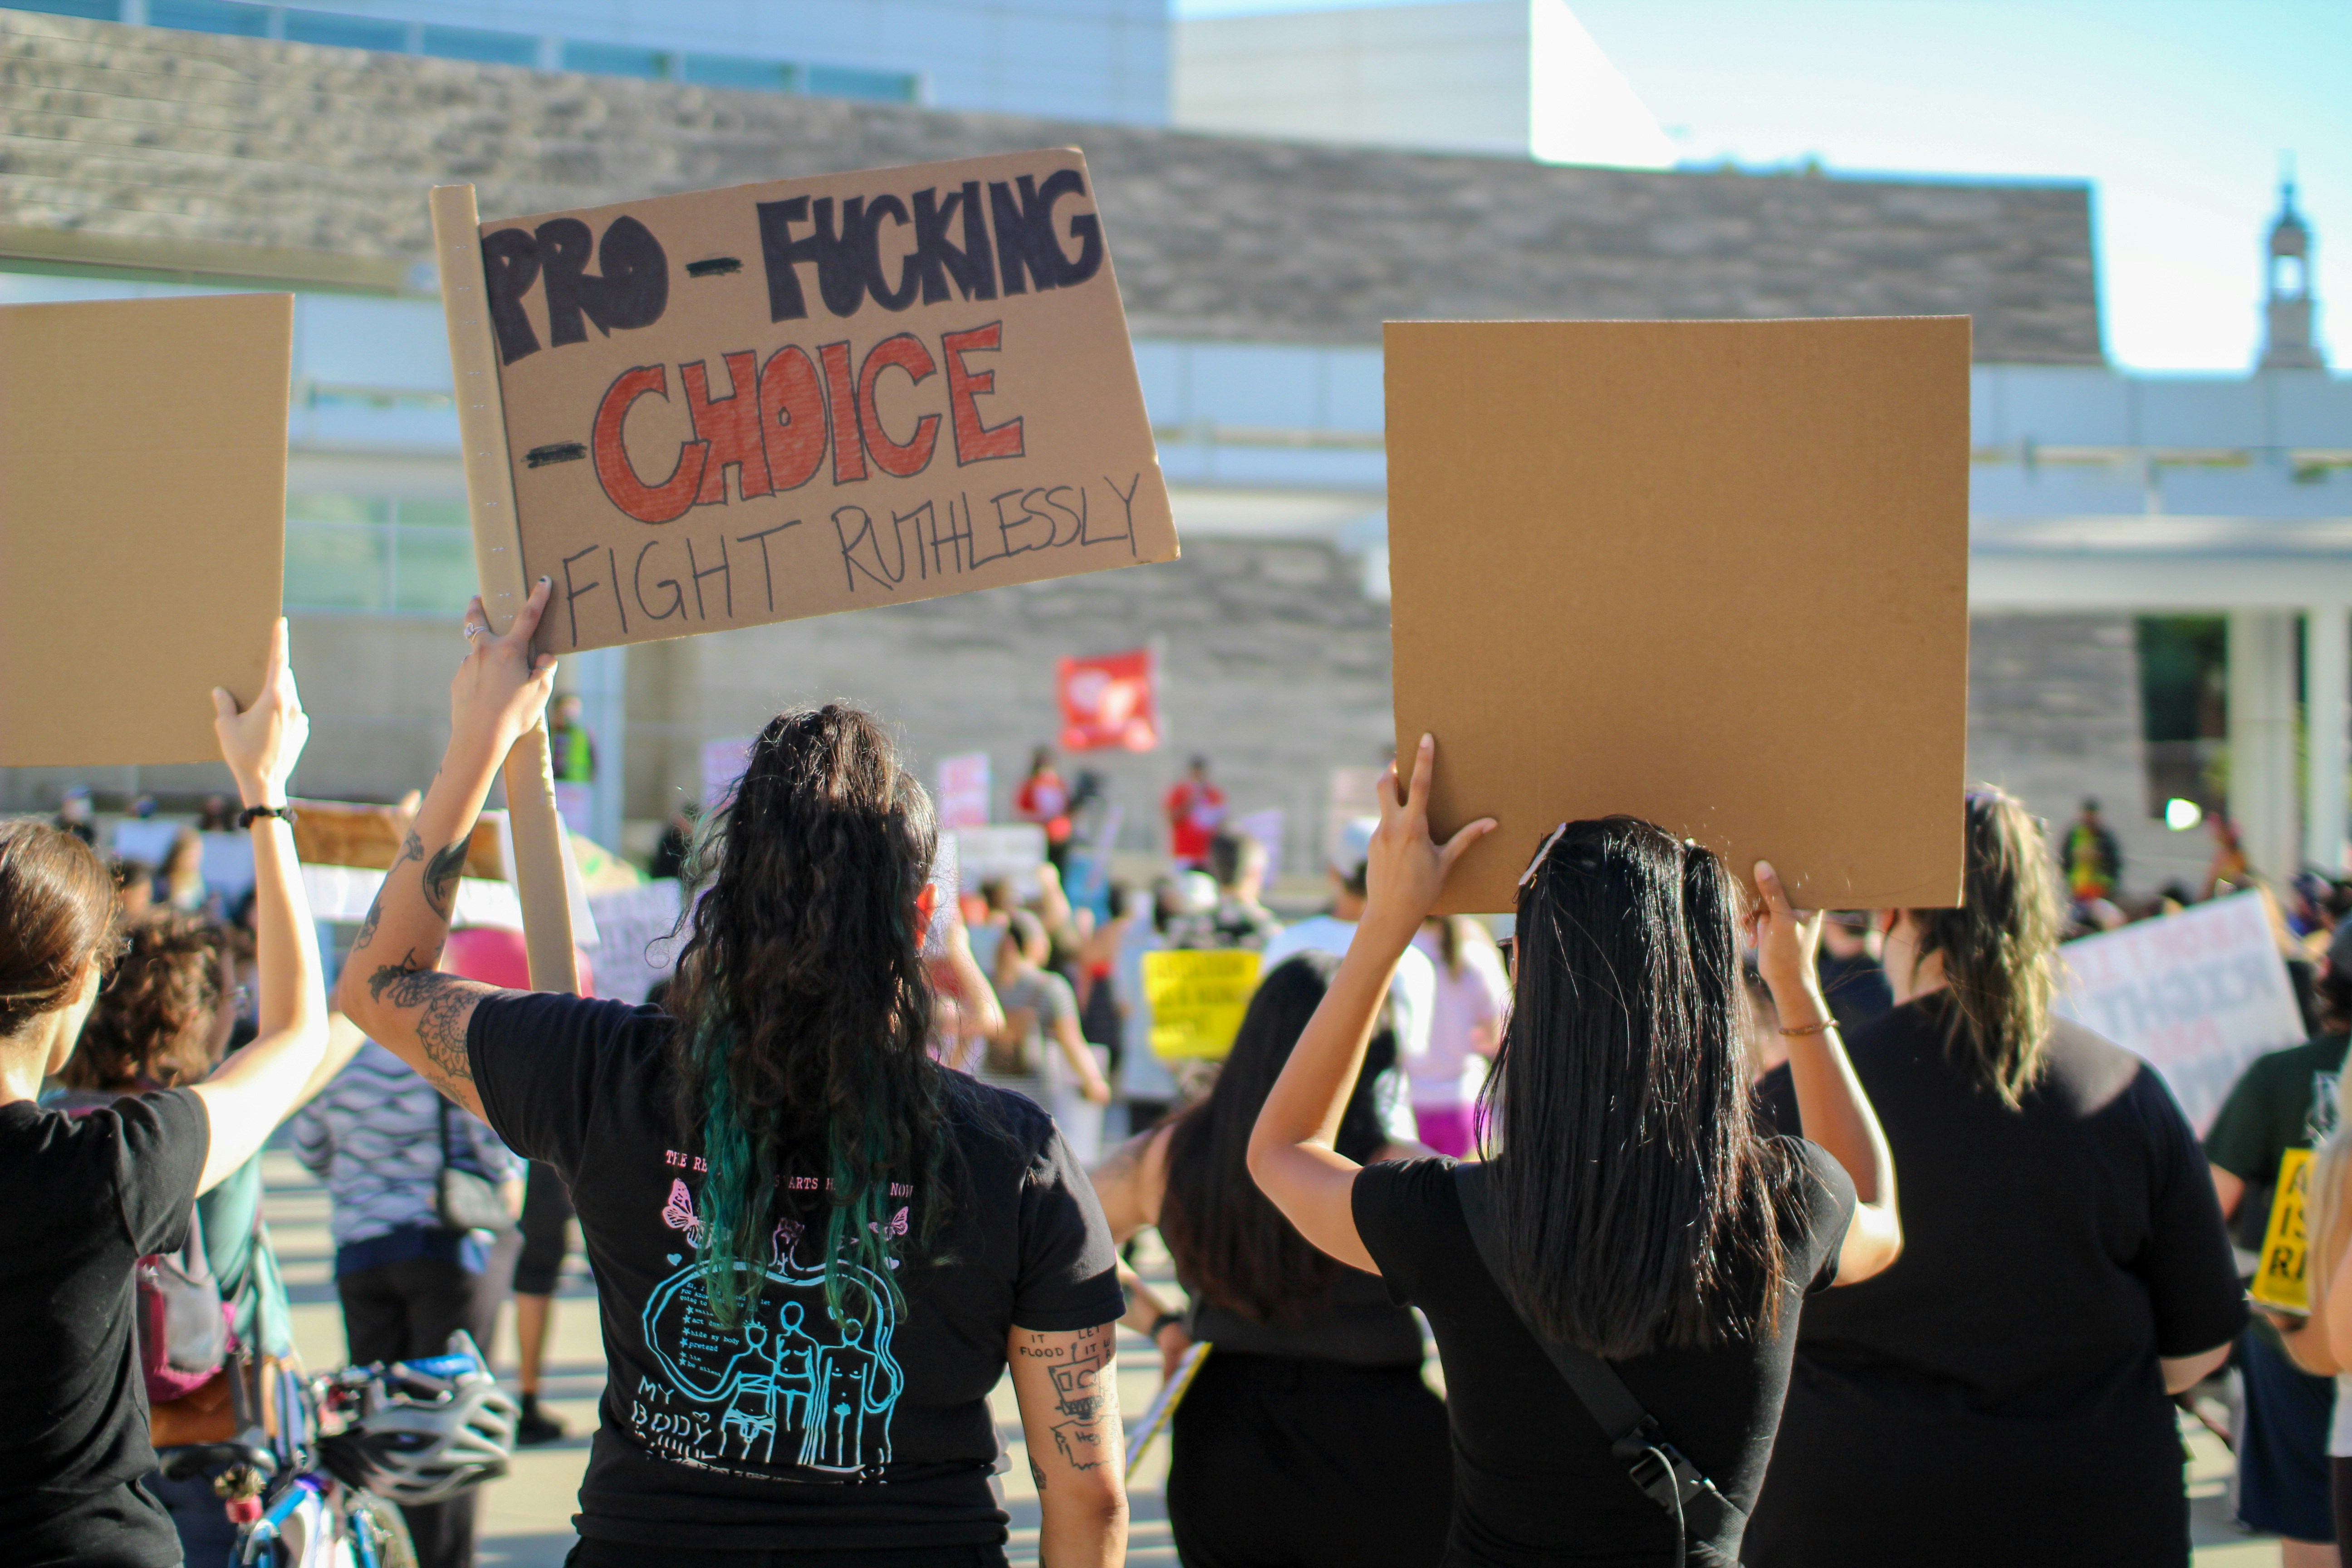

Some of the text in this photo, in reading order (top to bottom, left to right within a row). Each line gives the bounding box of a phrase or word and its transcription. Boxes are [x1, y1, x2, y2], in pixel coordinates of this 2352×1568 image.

[564, 473, 1140, 647] FIGHT RUTHLESSLY
[690, 1330, 708, 1338] hide
[723, 1336, 740, 1346] body
[1031, 1334, 1044, 1343] IT
[688, 1342, 718, 1352] pretend
[1020, 1346, 1064, 1357] FLOOD
[1085, 1343, 1097, 1355] IT
[638, 1375, 675, 1405] MY
[631, 1400, 712, 1445] BODY
